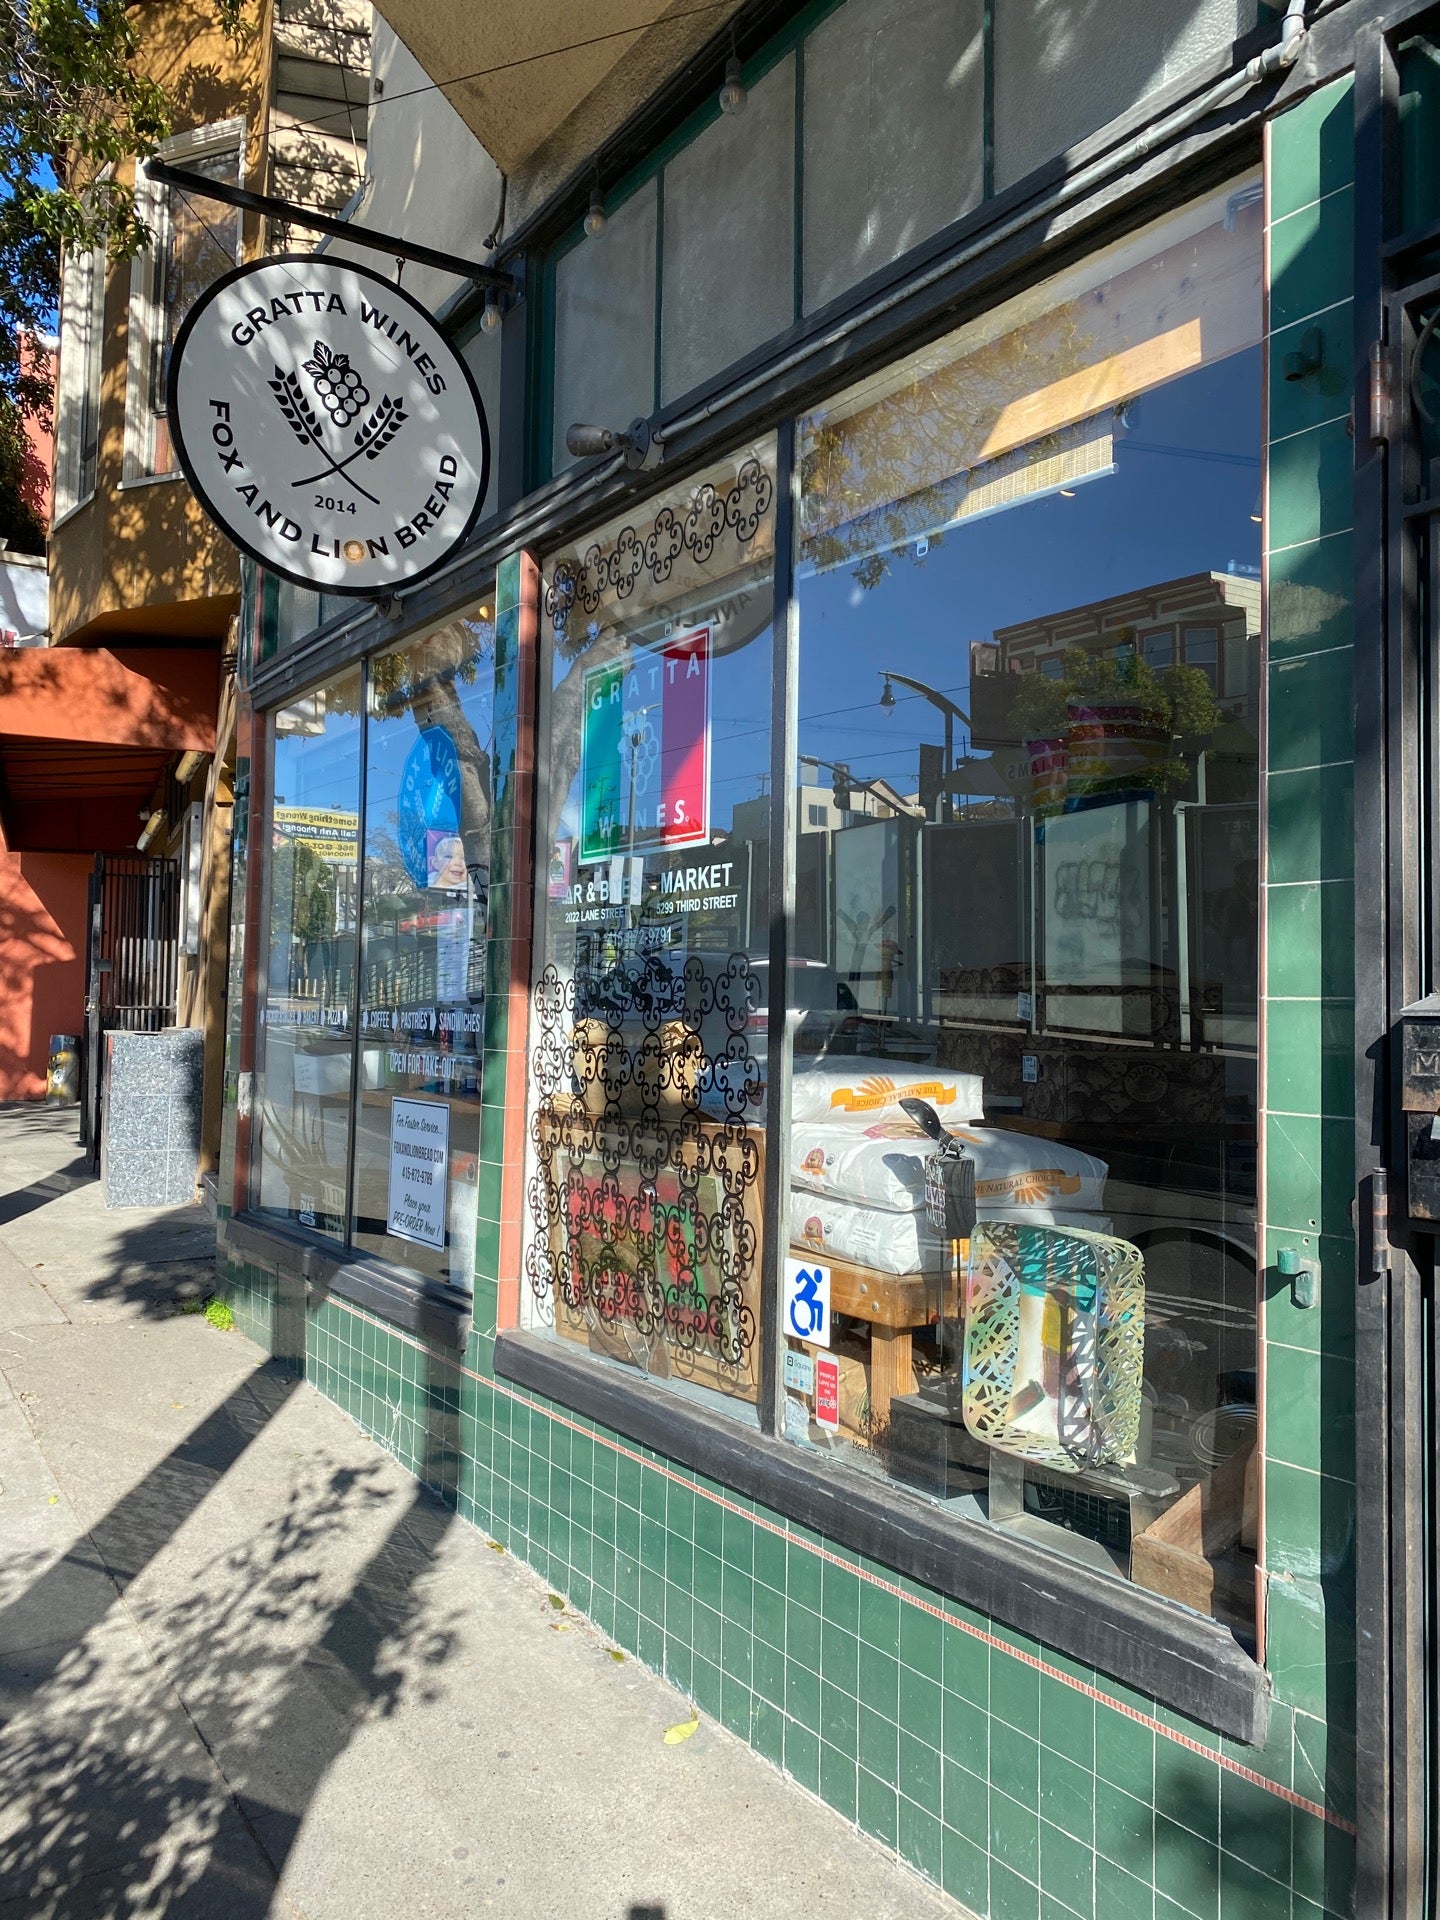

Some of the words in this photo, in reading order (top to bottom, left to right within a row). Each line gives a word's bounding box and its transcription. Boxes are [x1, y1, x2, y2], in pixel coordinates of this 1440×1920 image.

[231, 290, 348, 347] GRATTA
[359, 301, 448, 396] WINES
[208, 399, 245, 474] FOX
[234, 482, 303, 543] AND
[310, 533, 390, 566] LION
[393, 454, 458, 549] BREAD
[314, 494, 357, 515] 2014
[590, 652, 700, 710] GRATTA
[436, 742, 458, 796] LION
[661, 863, 733, 894] MARKET
[561, 883, 582, 905] AR
[586, 881, 597, 903] &
[565, 911, 580, 923] 2022
[581, 909, 600, 922] LANE
[601, 904, 627, 920] STREET
[656, 901, 674, 915] 5299
[676, 898, 701, 913] THIRD
[702, 894, 738, 911] STREET
[370, 1011, 390, 1028] COFFEE
[401, 1011, 428, 1030] PASTRIES
[439, 1012, 480, 1032] SANDWICHES
[389, 1052, 406, 1073] OPEN
[408, 1054, 421, 1075] FOR
[420, 1055, 457, 1080] TAKE-OUT
[856, 1097, 886, 1107] CHOICE
[889, 1087, 921, 1102] NATURAL
[986, 1178, 1024, 1194] NATURAL
[1025, 1174, 1057, 1185] CHOICE
[403, 1193, 418, 1209] Place
[392, 1210, 424, 1233] PRE-ORDER
[794, 1359, 812, 1372] Square
[819, 1371, 836, 1380] PEOPLE
